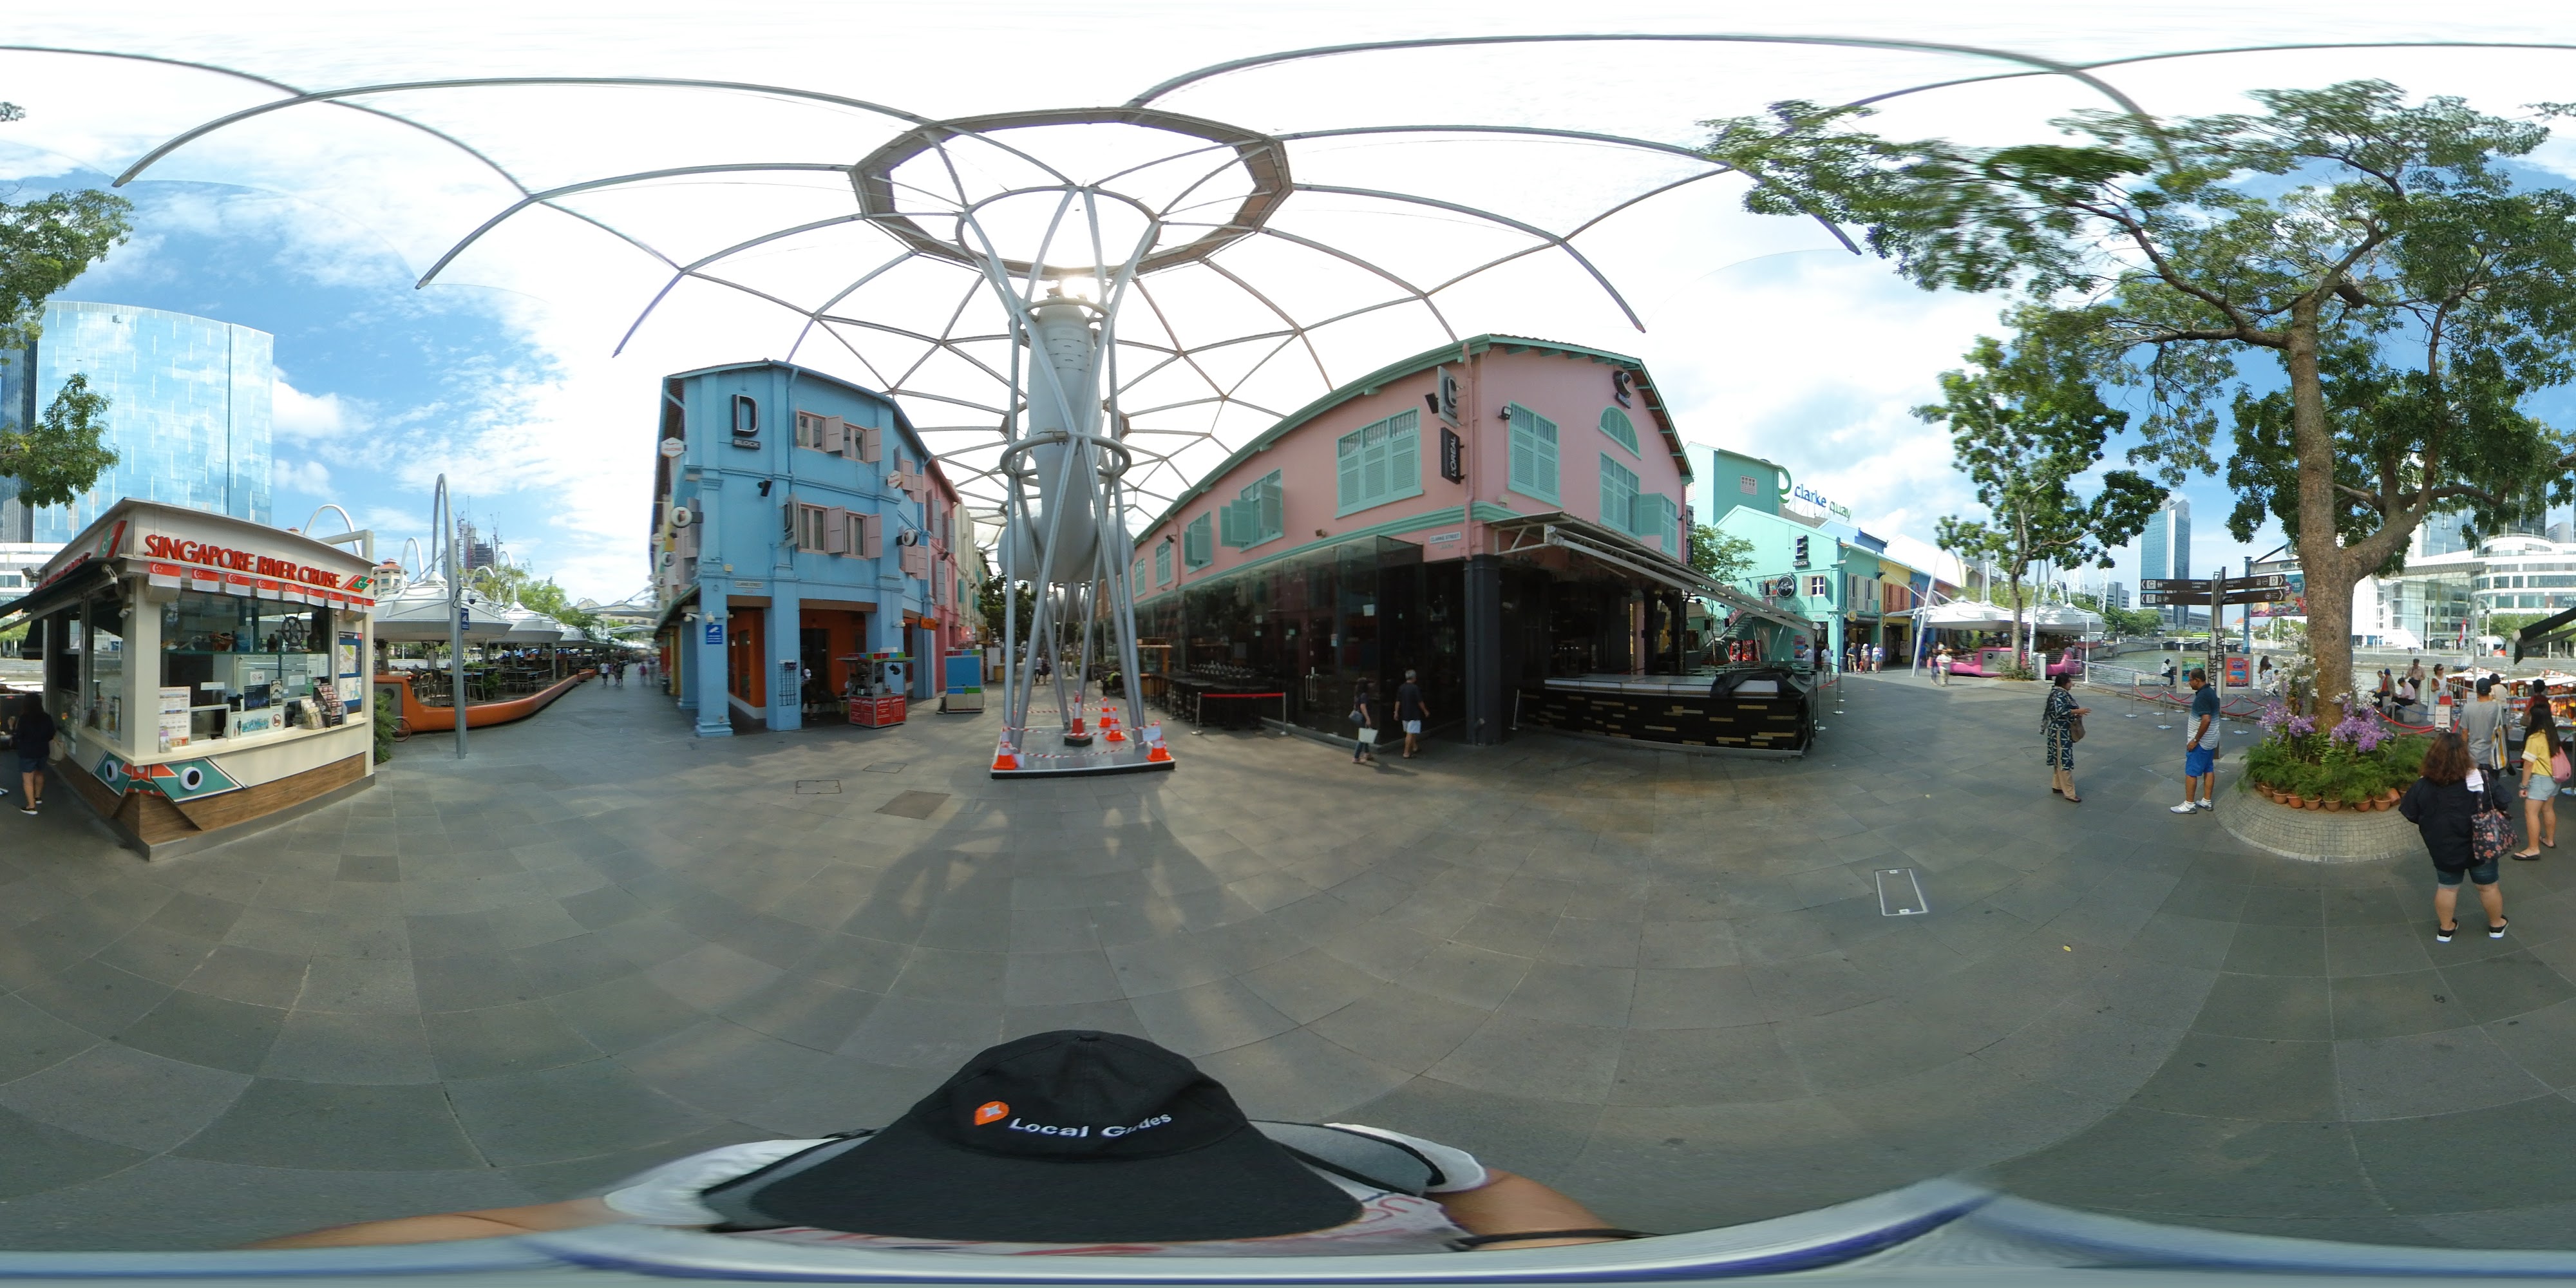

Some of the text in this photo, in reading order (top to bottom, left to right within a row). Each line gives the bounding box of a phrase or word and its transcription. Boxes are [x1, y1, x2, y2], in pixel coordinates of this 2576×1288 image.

[732, 394, 758, 437] D
[734, 439, 759, 448] BLOCK
[1794, 484, 1852, 522] clarke quay
[144, 534, 341, 589] SINGAPORE RIVER CRUISE
[1795, 535, 1809, 559] E
[1009, 1117, 1089, 1137] Local
